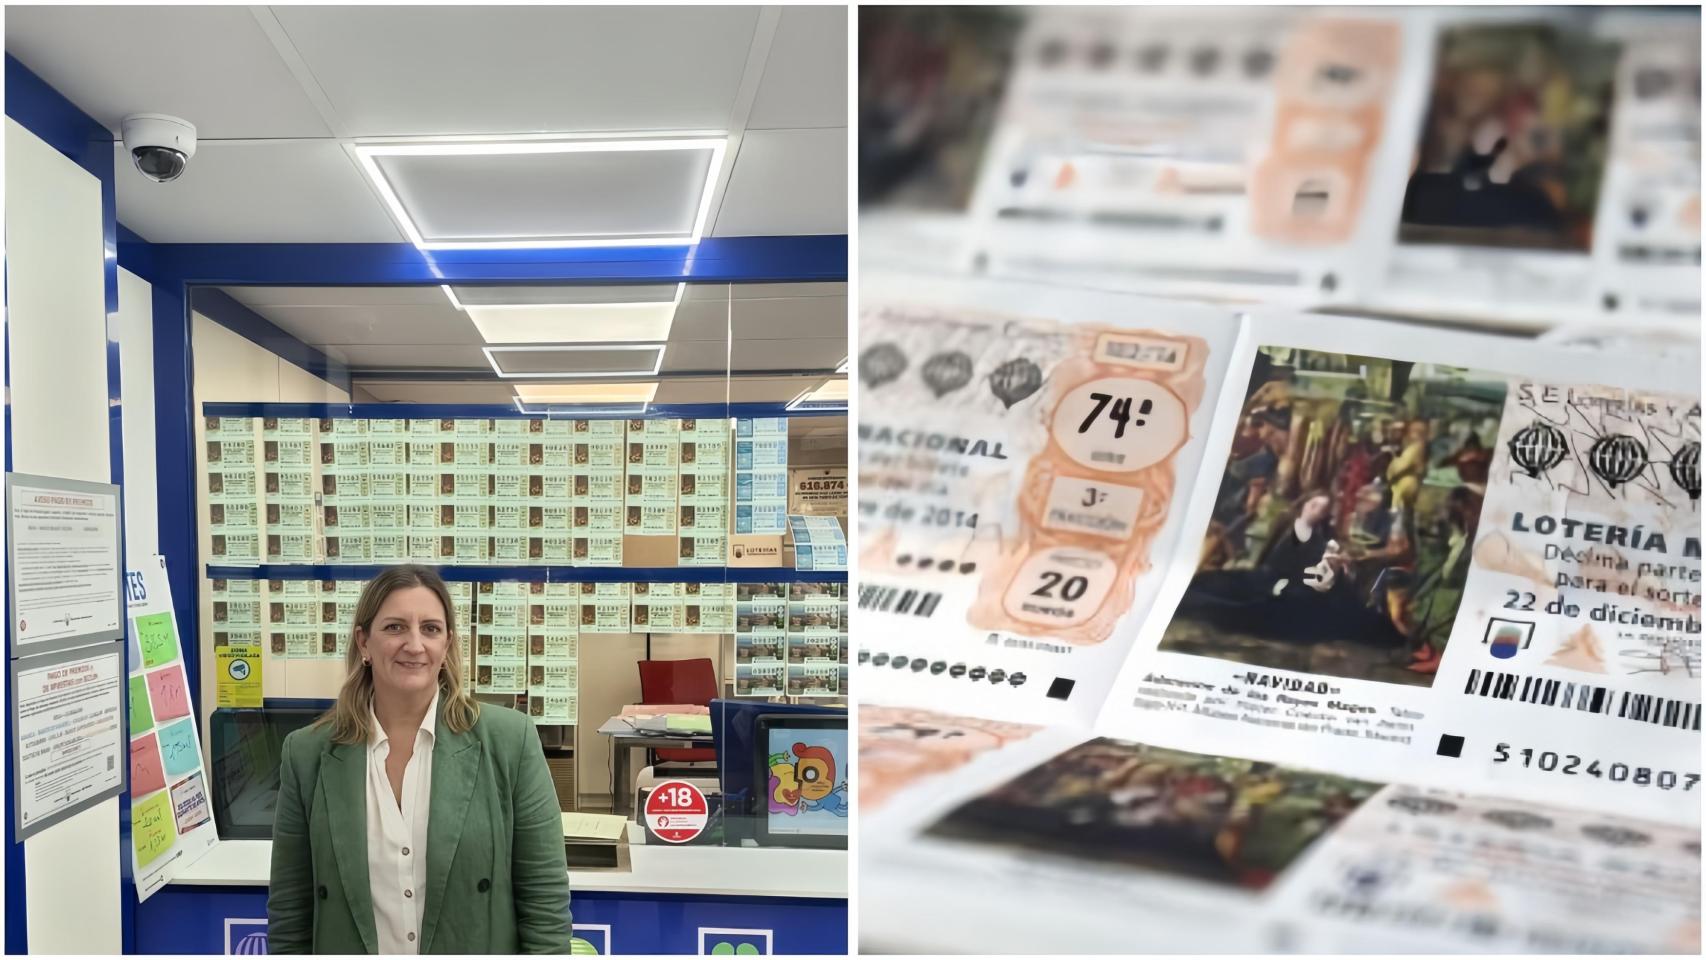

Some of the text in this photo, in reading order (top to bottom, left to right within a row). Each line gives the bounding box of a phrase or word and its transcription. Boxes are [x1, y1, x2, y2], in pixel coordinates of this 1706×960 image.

[1511, 511, 1667, 554] LOTERÍA
[1030, 571, 1089, 602] 20
[1503, 588, 1537, 612] 22
[658, 787, 693, 807] +18
